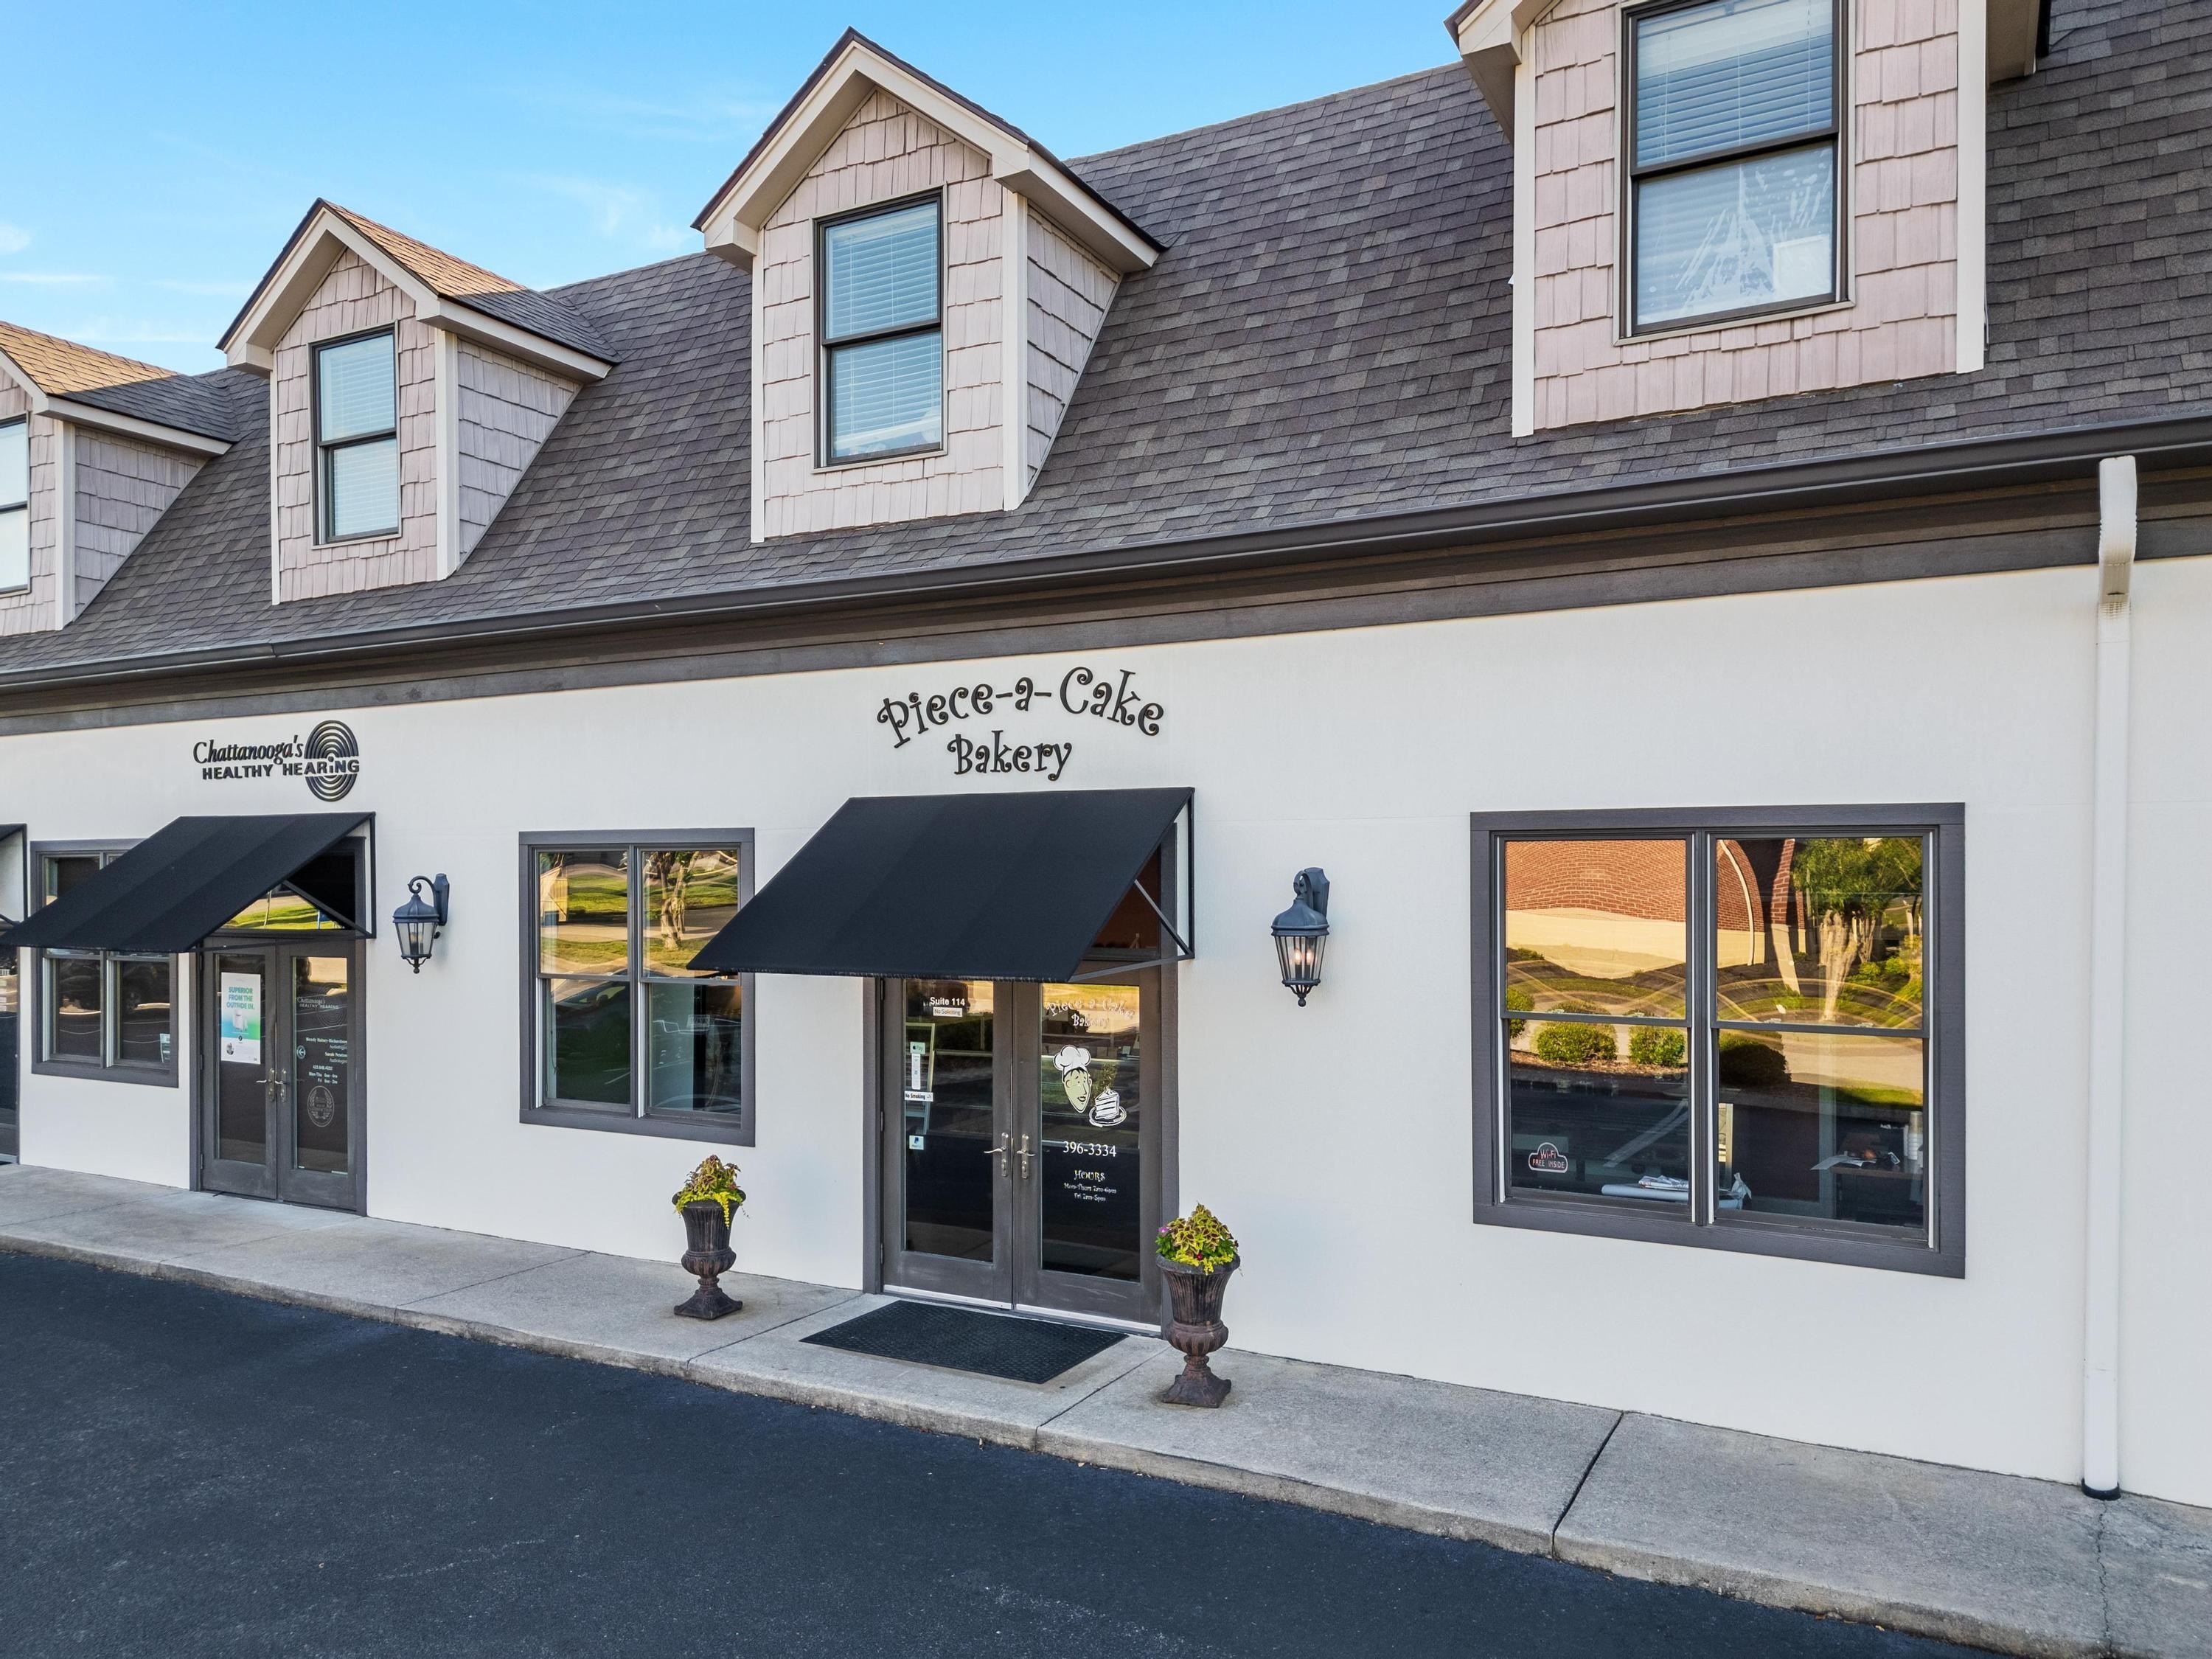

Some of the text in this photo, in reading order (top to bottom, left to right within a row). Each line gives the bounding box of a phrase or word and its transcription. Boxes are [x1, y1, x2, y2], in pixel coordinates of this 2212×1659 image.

[193, 734, 303, 765] Chattanooga's
[947, 730, 1073, 782] Bakery
[202, 764, 274, 780] HEALTHY
[930, 997, 965, 1006] Suite 114
[1071, 1013, 1110, 1029] Bakery
[911, 1092, 925, 1100] Smoking
[1062, 1141, 1116, 1157] 396-3334
[1540, 1149, 1557, 1159] Wi-Fi
[1532, 1158, 1565, 1168] FREE INSIDE
[1074, 1169, 1106, 1182] HOURS
